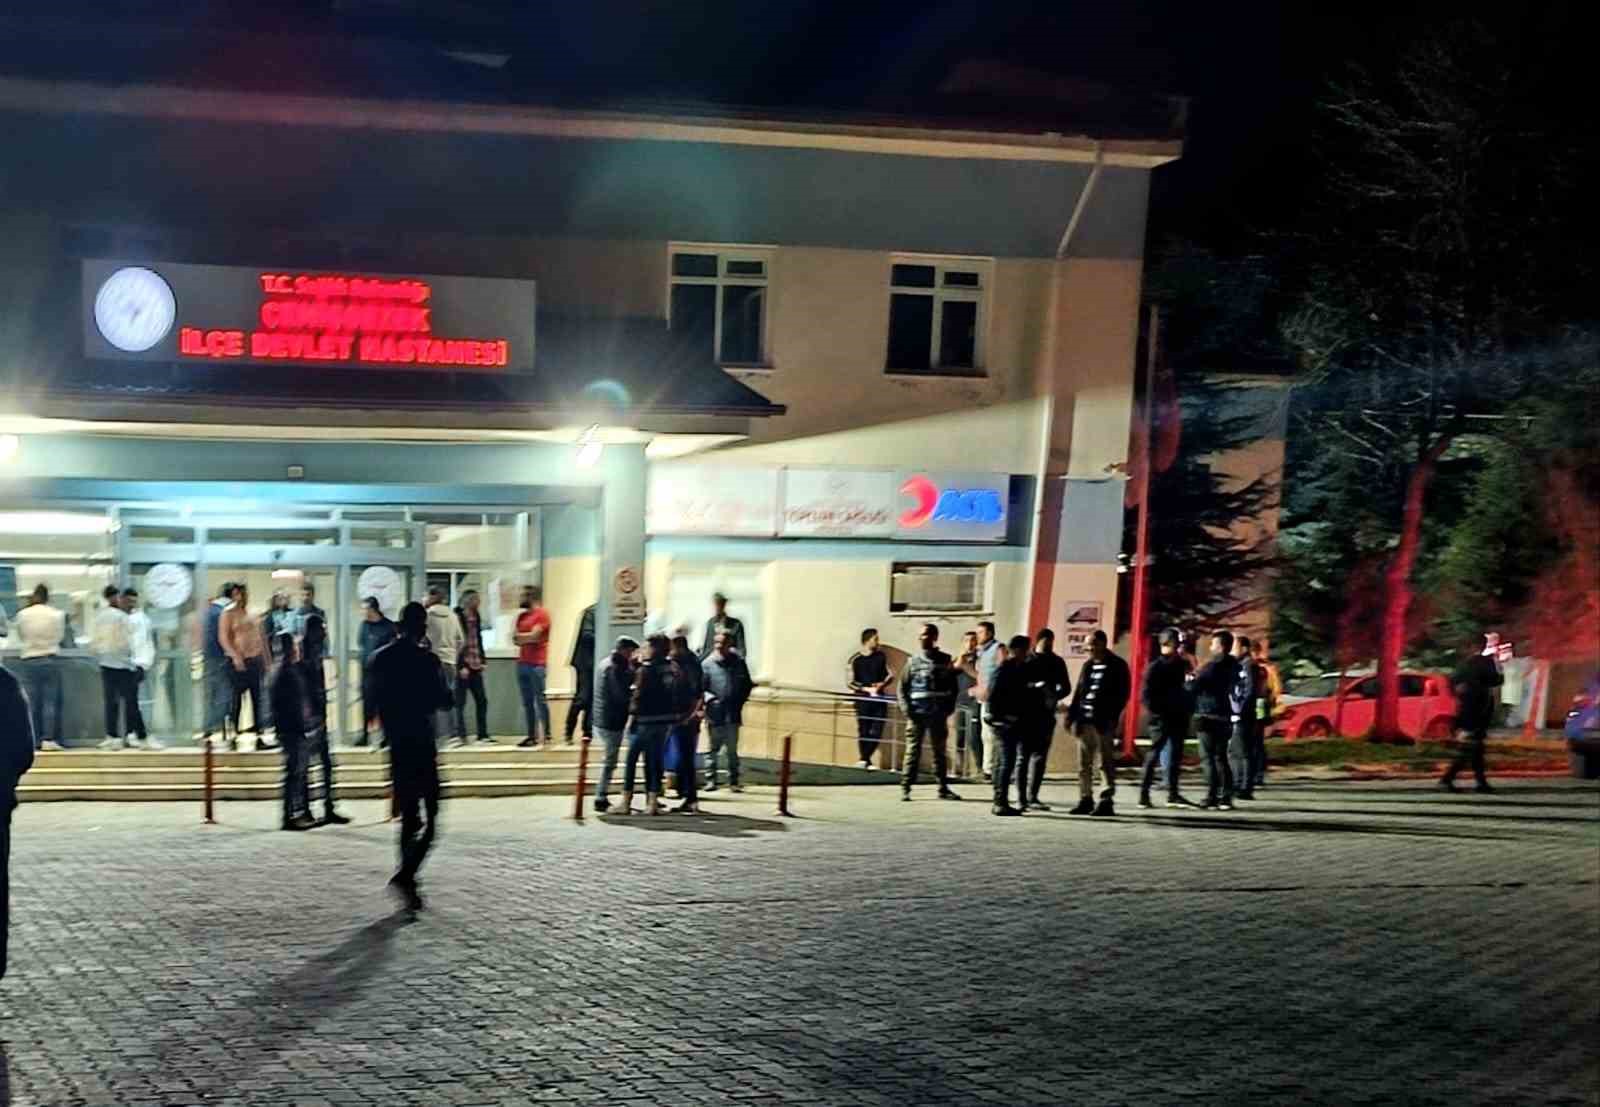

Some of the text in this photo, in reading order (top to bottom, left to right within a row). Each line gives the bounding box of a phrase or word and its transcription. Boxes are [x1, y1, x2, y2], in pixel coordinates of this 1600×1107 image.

[180, 327, 507, 366] İLÇE DEVLET HASTANESİ
